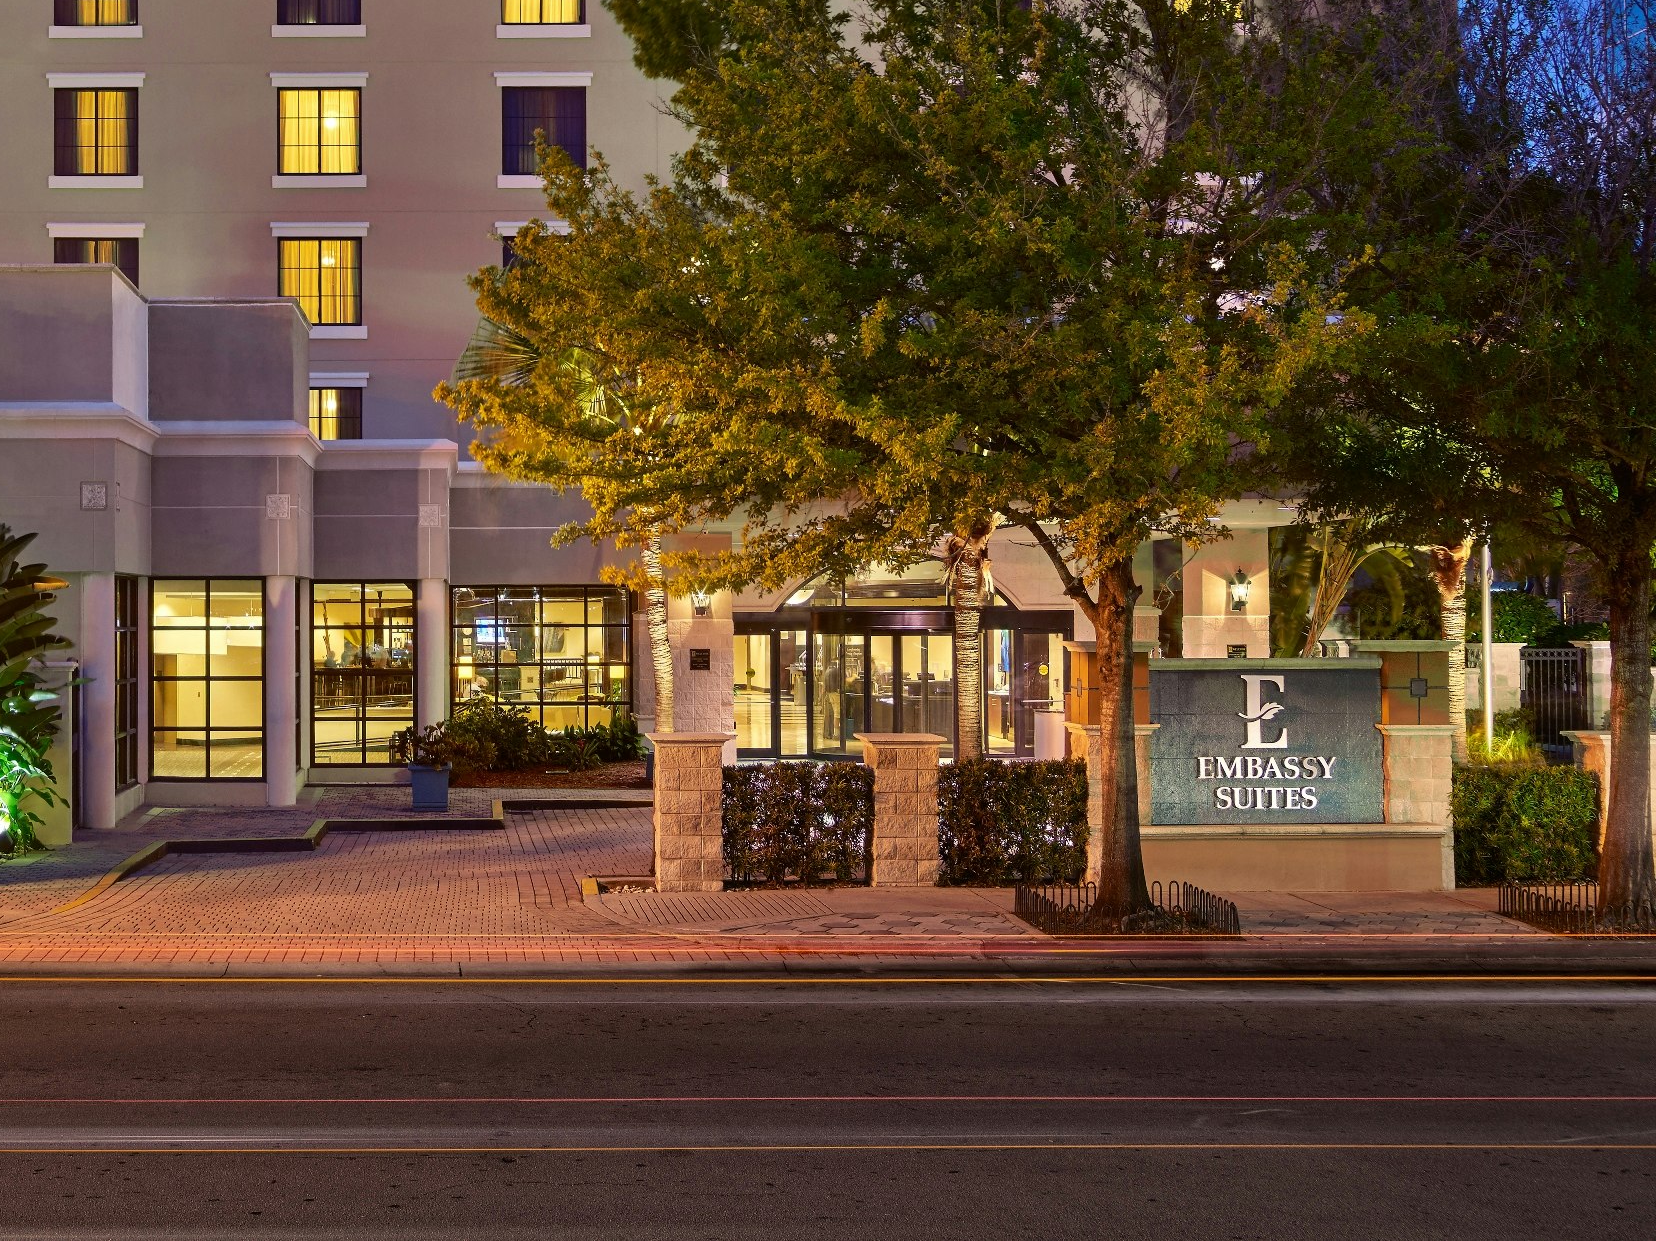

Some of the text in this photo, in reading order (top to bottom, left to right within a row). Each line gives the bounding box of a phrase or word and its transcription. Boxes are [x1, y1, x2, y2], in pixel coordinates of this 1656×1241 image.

[1238, 674, 1288, 749] E
[1197, 756, 1336, 780] EMBASSY
[1216, 786, 1318, 810] SUITES
